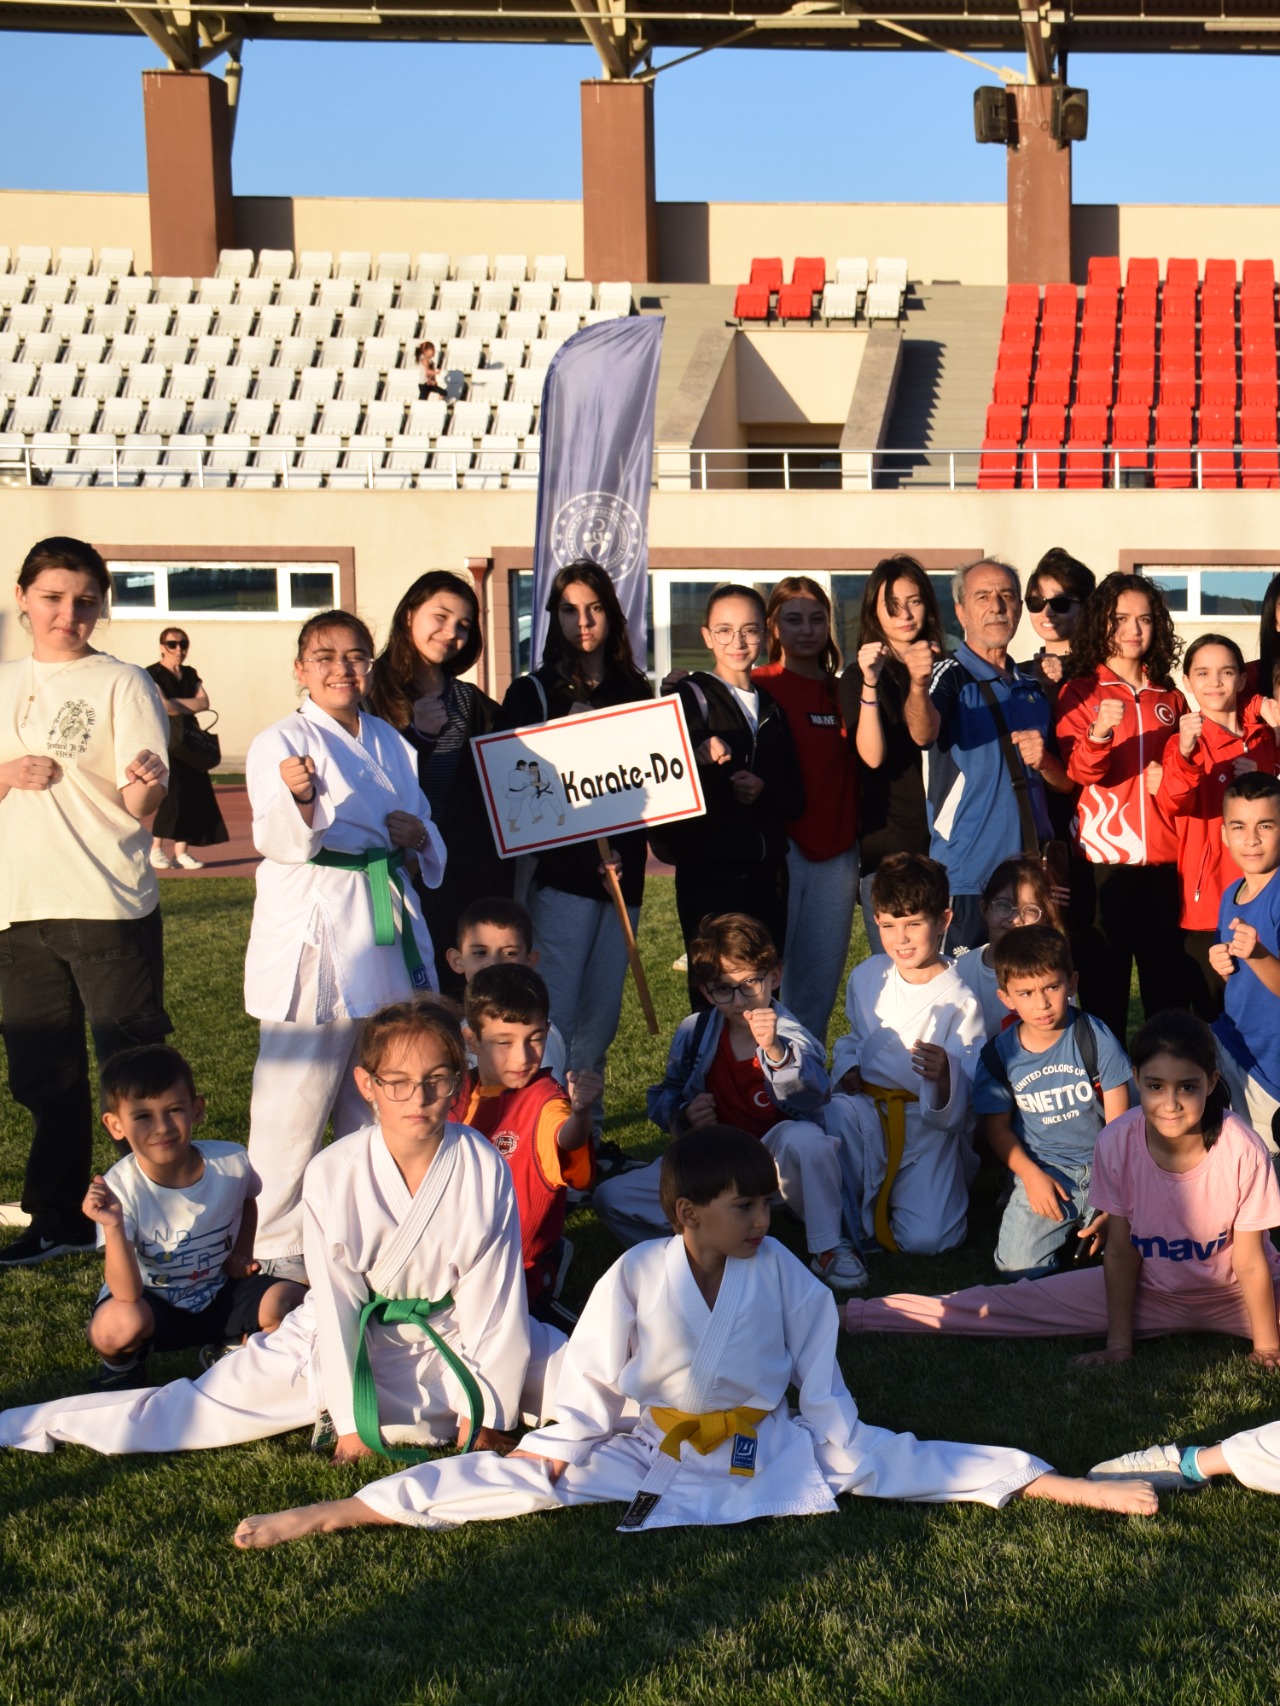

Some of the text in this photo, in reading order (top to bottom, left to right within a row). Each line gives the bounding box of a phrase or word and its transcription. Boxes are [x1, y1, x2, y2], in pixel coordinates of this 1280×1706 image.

[811, 714, 836, 725] MARVE
[561, 752, 684, 804] Karate-Do
[1014, 1070, 1042, 1093] UNITED
[1042, 1063, 1074, 1075] COLORS
[1014, 1080, 1093, 1114] ENETTO
[1041, 1109, 1080, 1125] SINCE 1979
[1130, 1229, 1228, 1262] mavi
